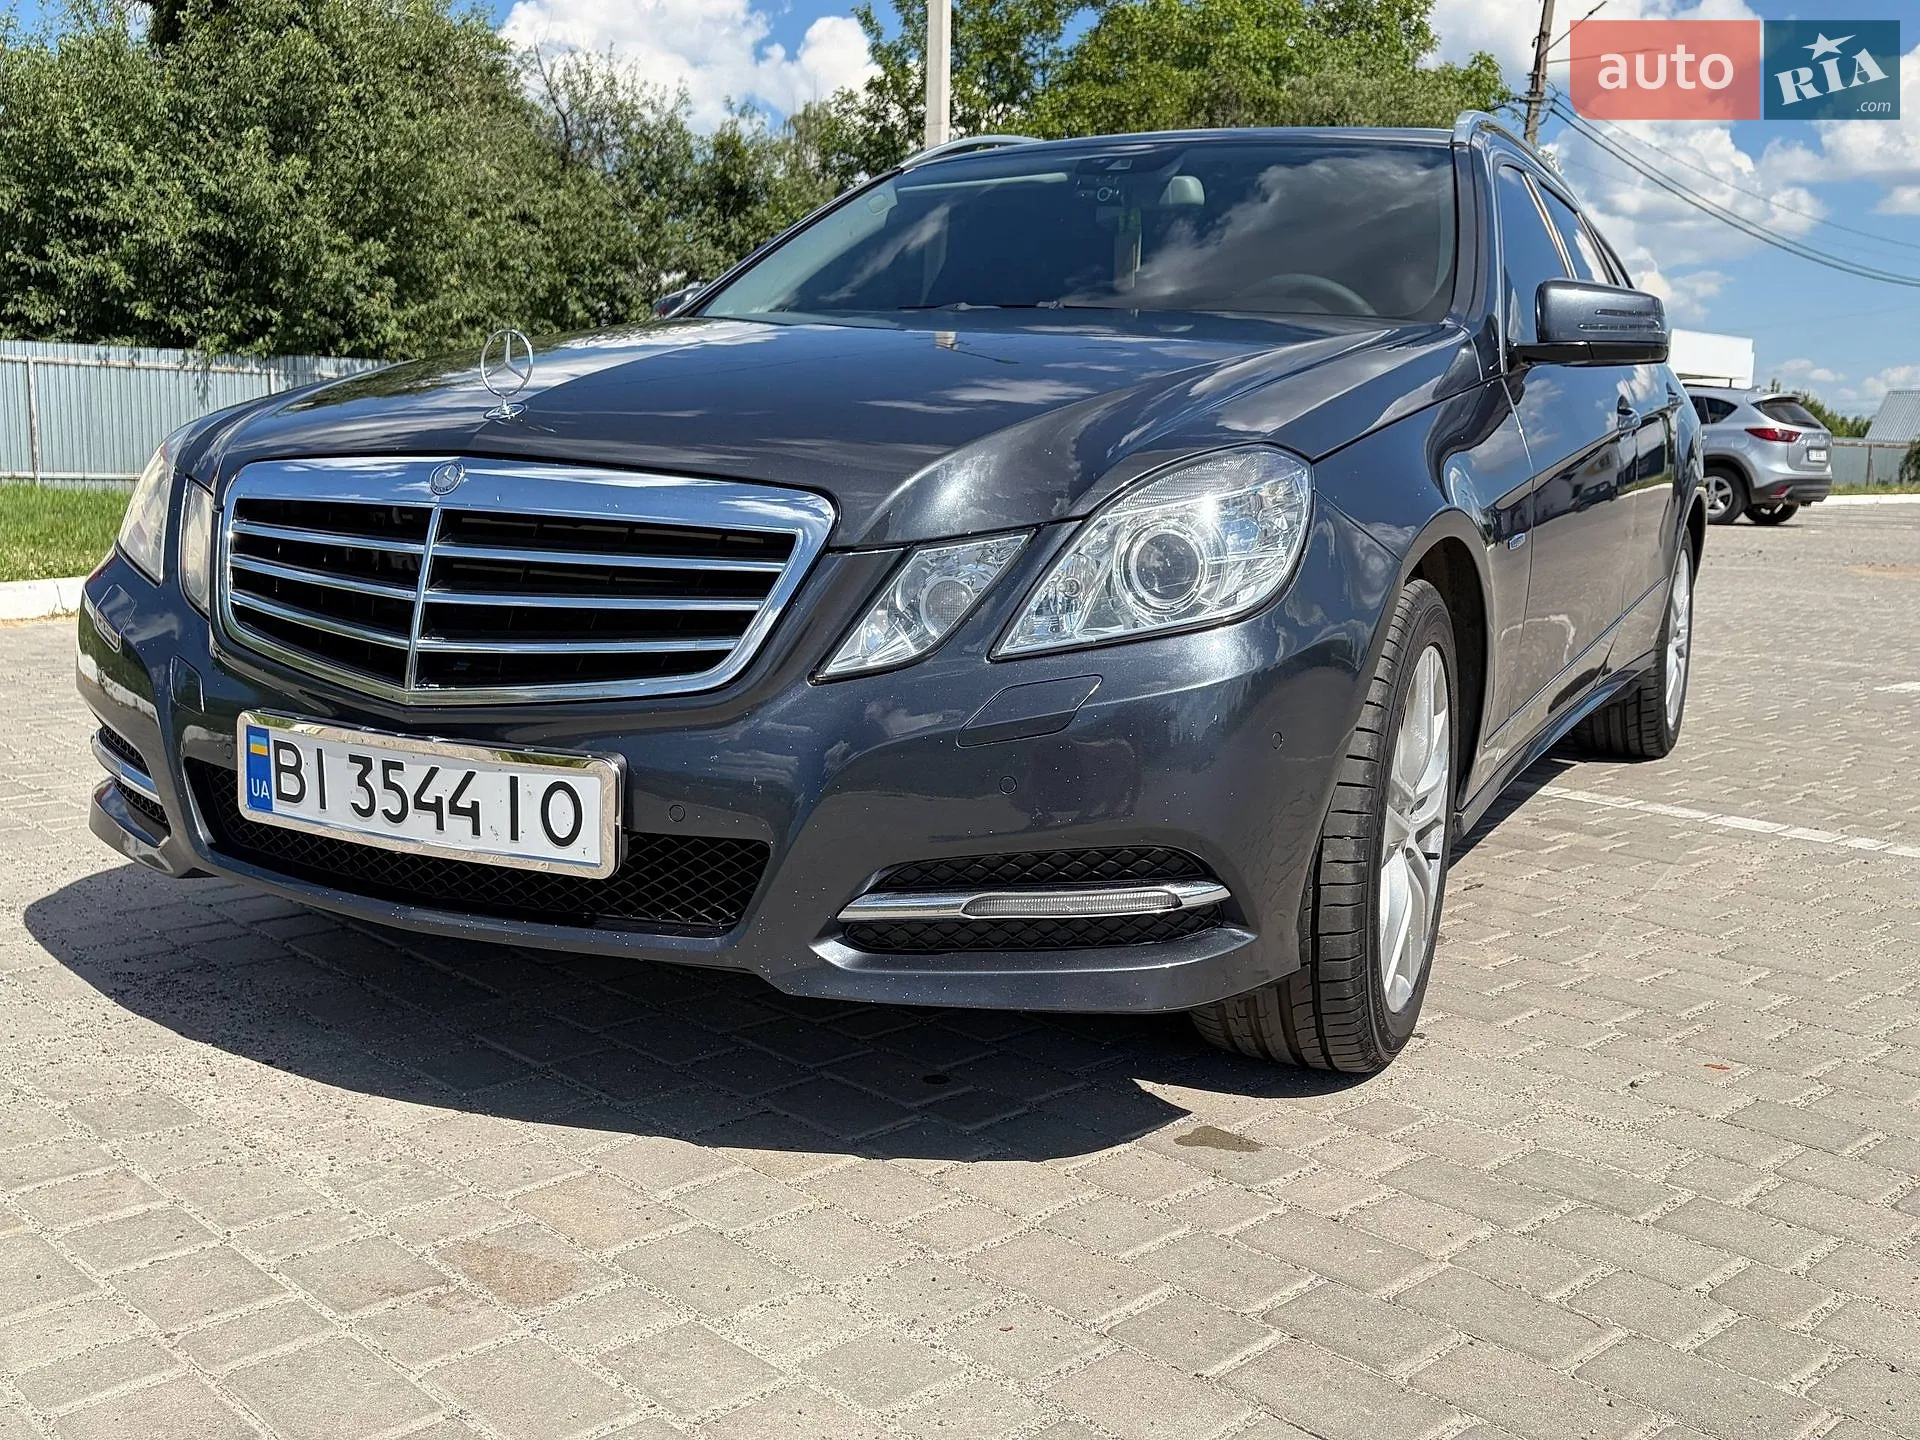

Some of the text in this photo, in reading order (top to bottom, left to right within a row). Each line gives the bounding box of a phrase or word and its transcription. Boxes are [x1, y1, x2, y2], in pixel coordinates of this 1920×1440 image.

[250, 778, 271, 801] UA
[272, 738, 584, 848] BI 3544 IO
